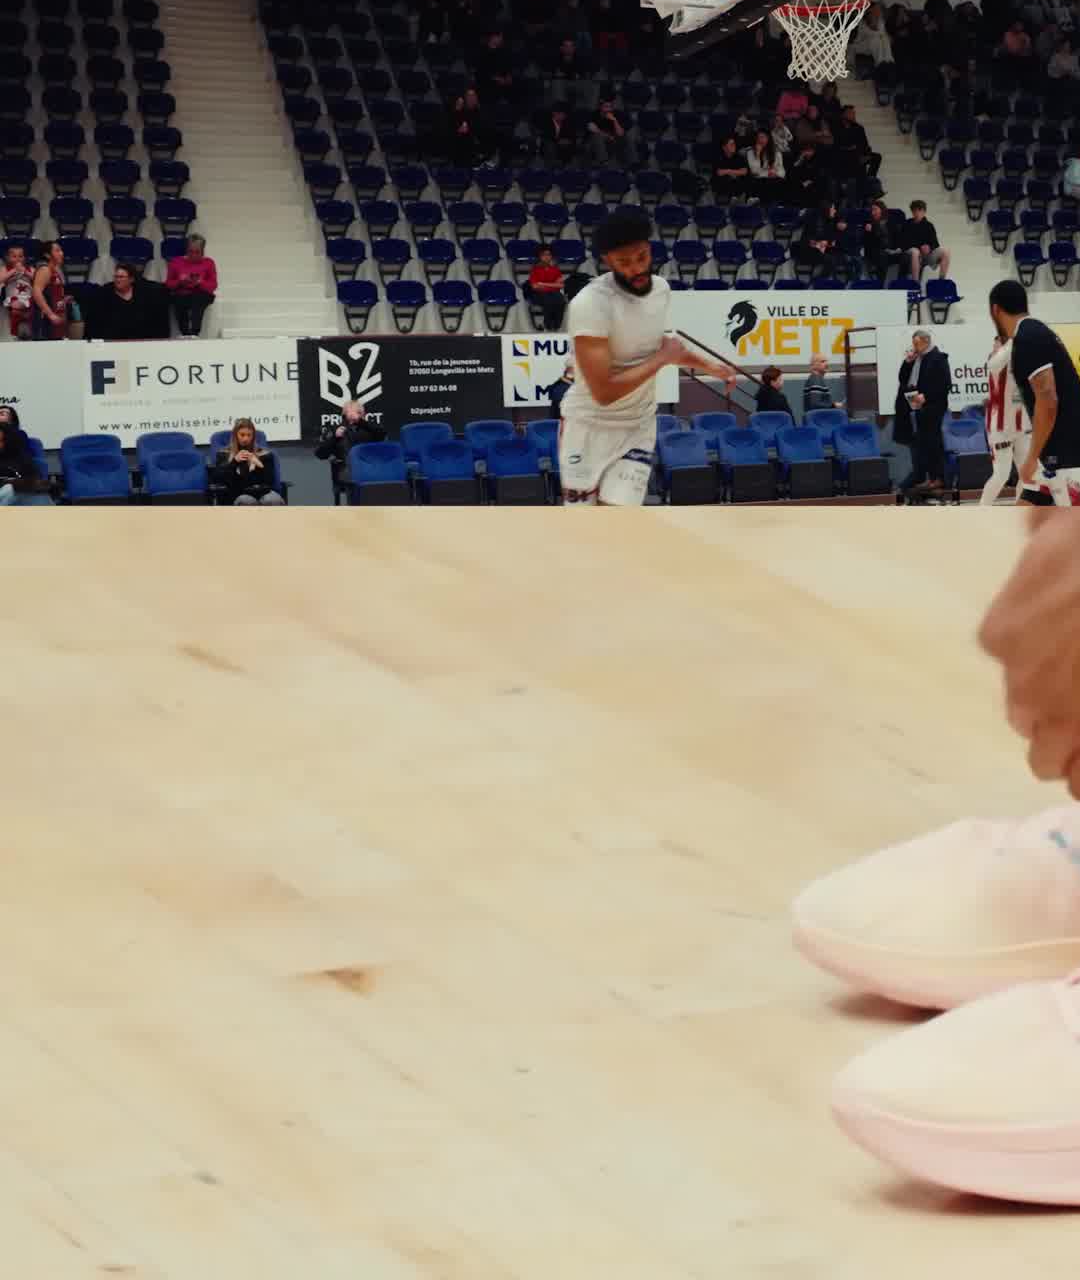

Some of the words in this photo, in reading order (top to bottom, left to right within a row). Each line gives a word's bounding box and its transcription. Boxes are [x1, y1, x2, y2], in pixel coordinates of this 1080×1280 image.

[767, 306, 806, 316] VILLE
[811, 306, 829, 316] DE
[737, 318, 855, 356] METZ
[136, 361, 299, 386] FORTUNE
